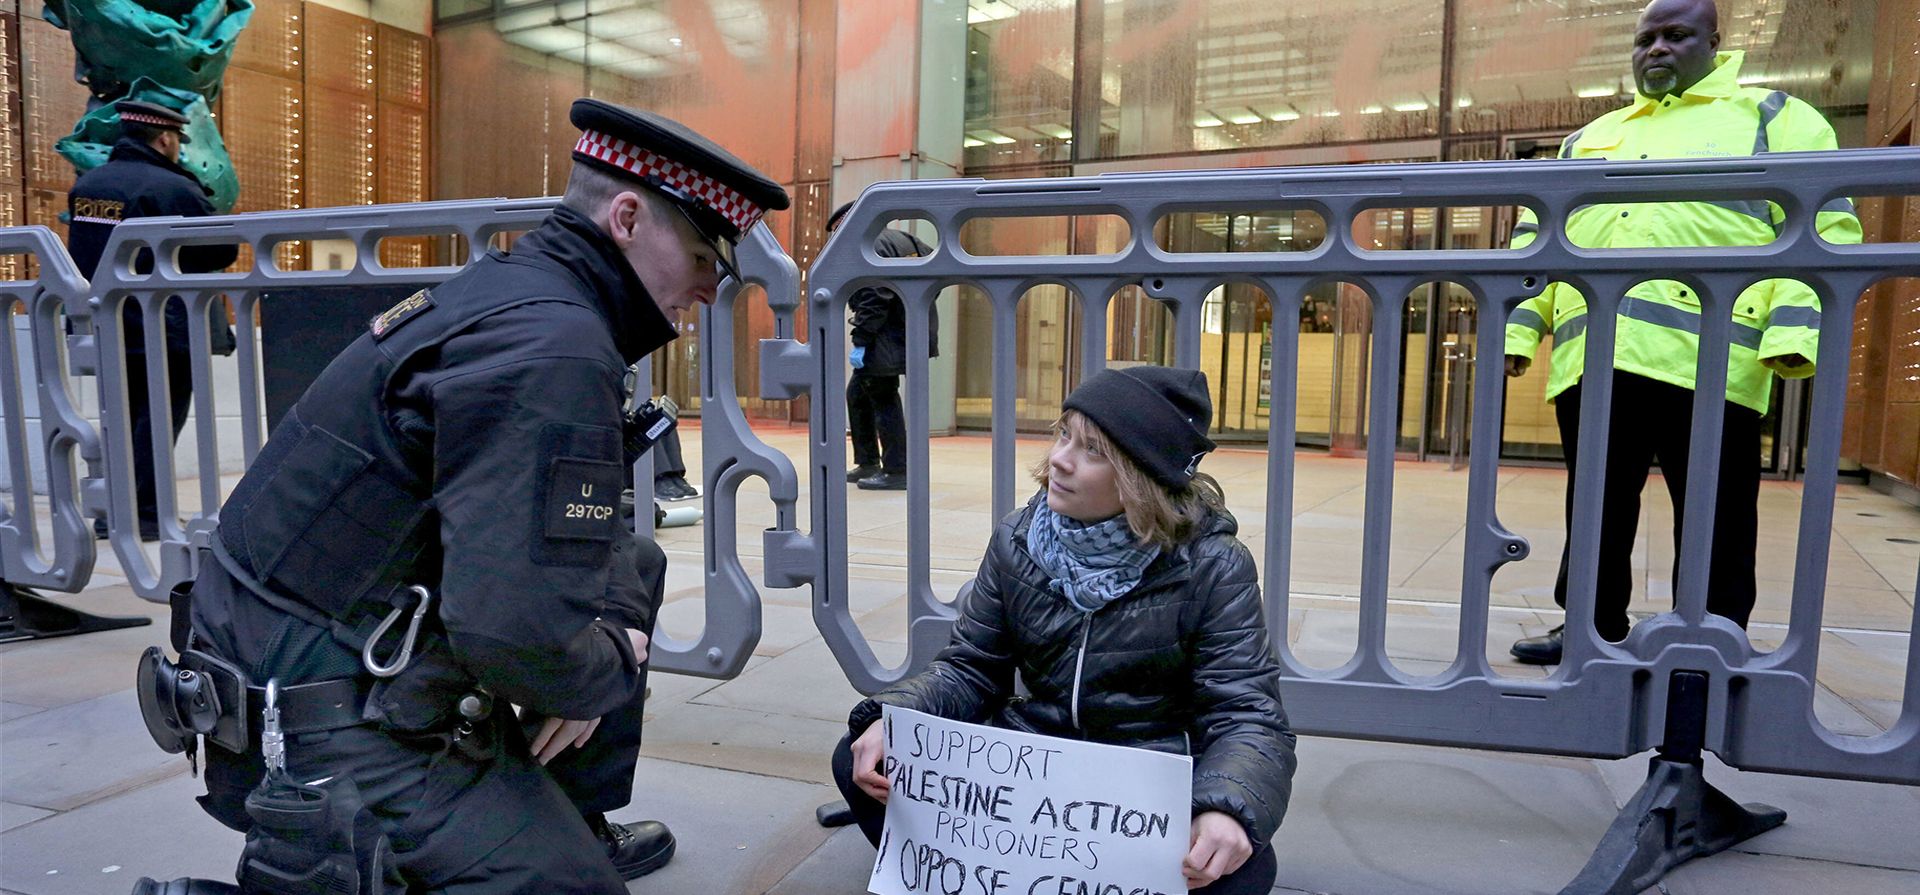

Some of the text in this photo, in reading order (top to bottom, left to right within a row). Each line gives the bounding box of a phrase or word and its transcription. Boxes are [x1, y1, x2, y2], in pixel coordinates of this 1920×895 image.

[74, 203, 122, 219] POLICE
[565, 503, 613, 520] 297CP
[581, 483, 593, 498] U
[884, 714, 1063, 782] I SUPPORT
[885, 756, 1170, 839] PALESTINE ACTION
[876, 828, 890, 874] I
[900, 838, 1011, 895] OPPOSE
[935, 811, 1101, 870] PRISONERS
